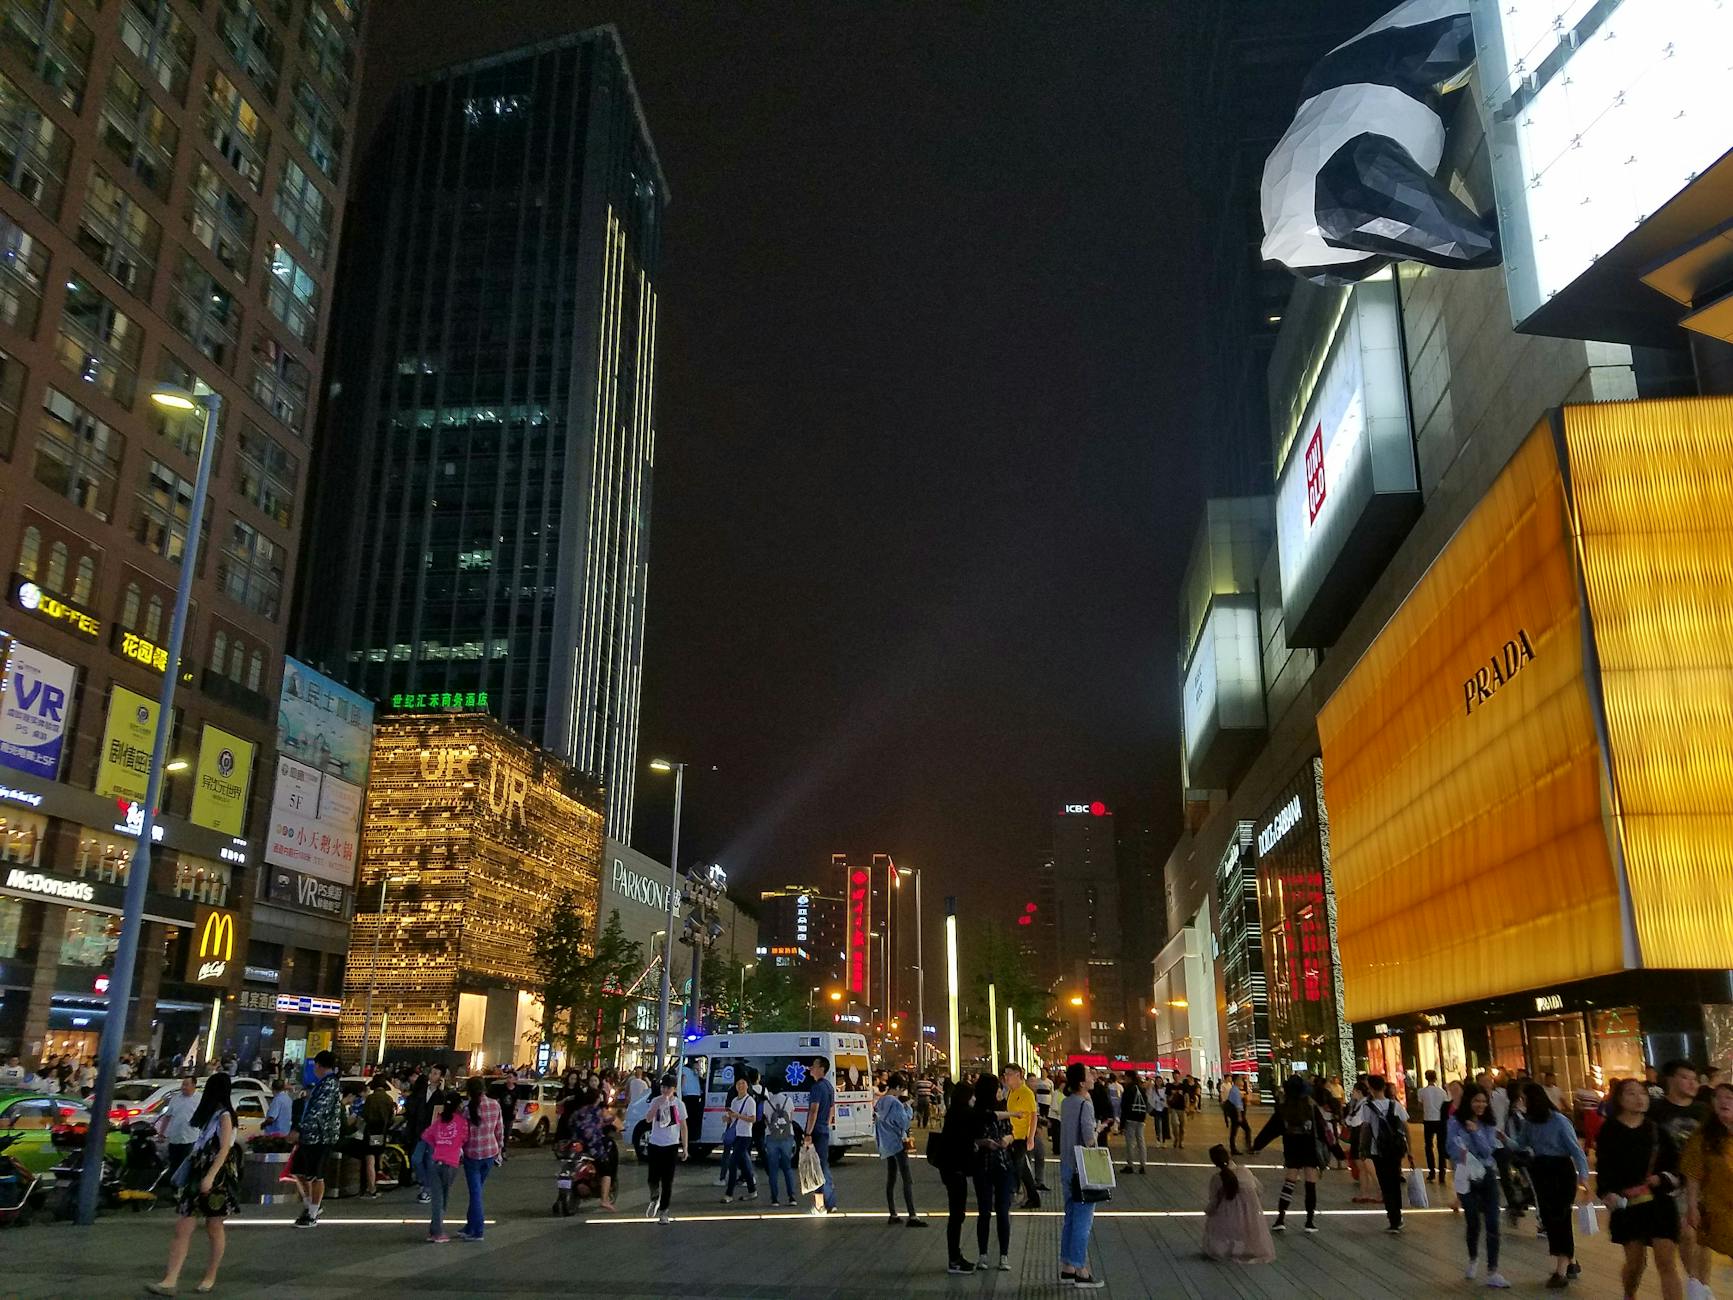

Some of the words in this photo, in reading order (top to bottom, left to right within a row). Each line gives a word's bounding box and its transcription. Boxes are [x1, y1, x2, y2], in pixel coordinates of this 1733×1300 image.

[14, 672, 65, 722] VR
[1463, 628, 1536, 716] PRADA
[1065, 804, 1090, 813] ICBC
[298, 875, 319, 909] VR
[612, 858, 663, 910] PARKSON
